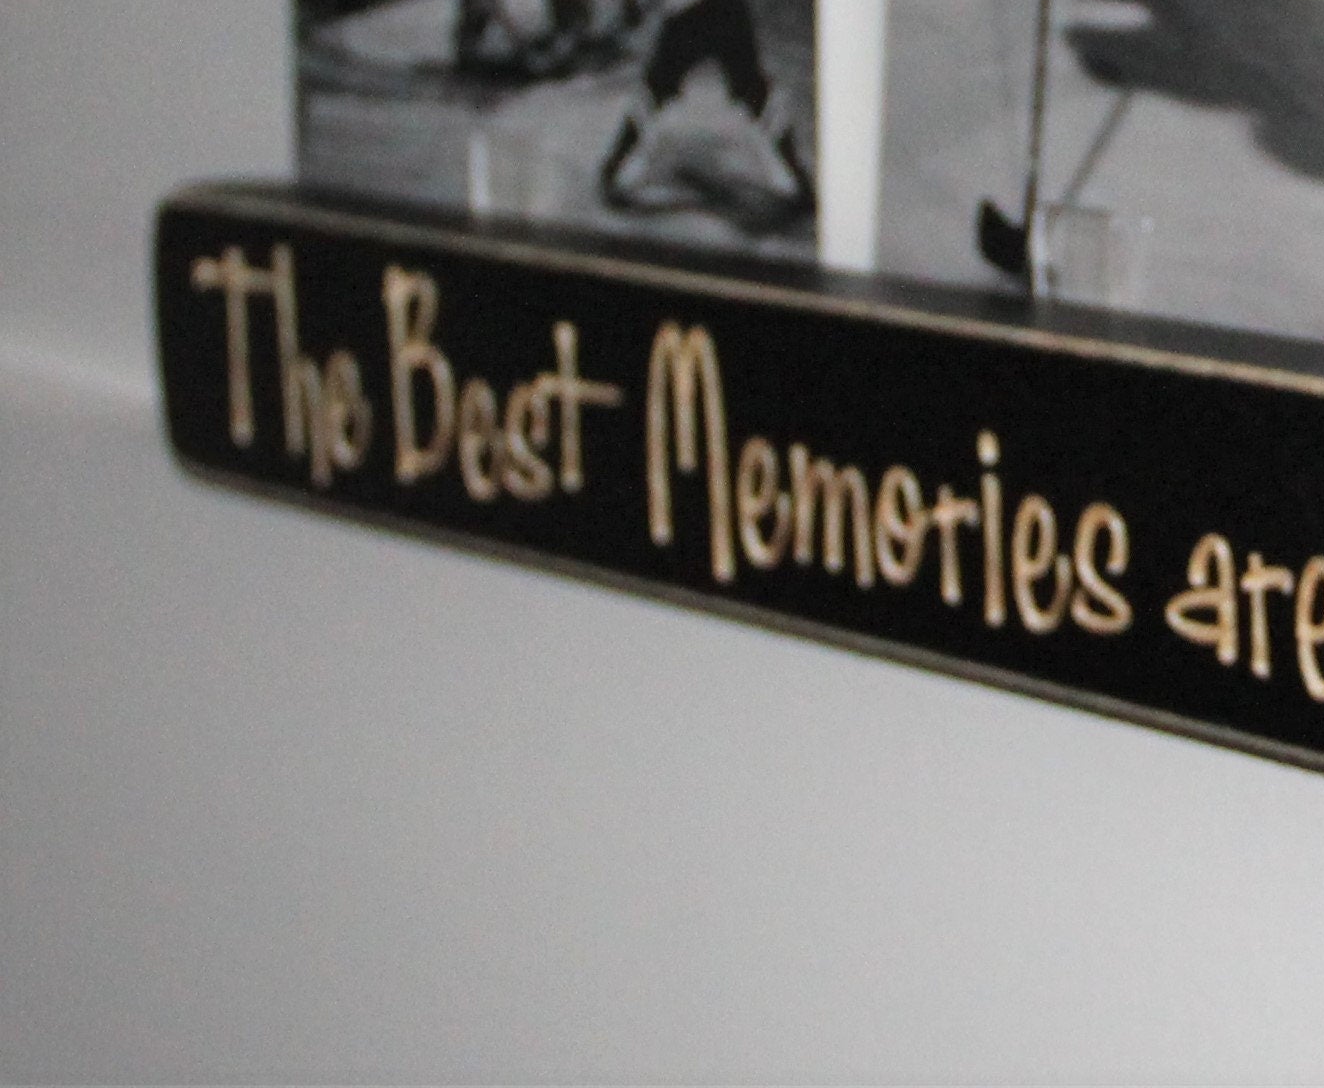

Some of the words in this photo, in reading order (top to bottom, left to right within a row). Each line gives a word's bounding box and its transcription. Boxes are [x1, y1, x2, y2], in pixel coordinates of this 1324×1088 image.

[192, 245, 372, 487] The
[384, 265, 622, 502] Best
[646, 322, 1132, 635] Memories
